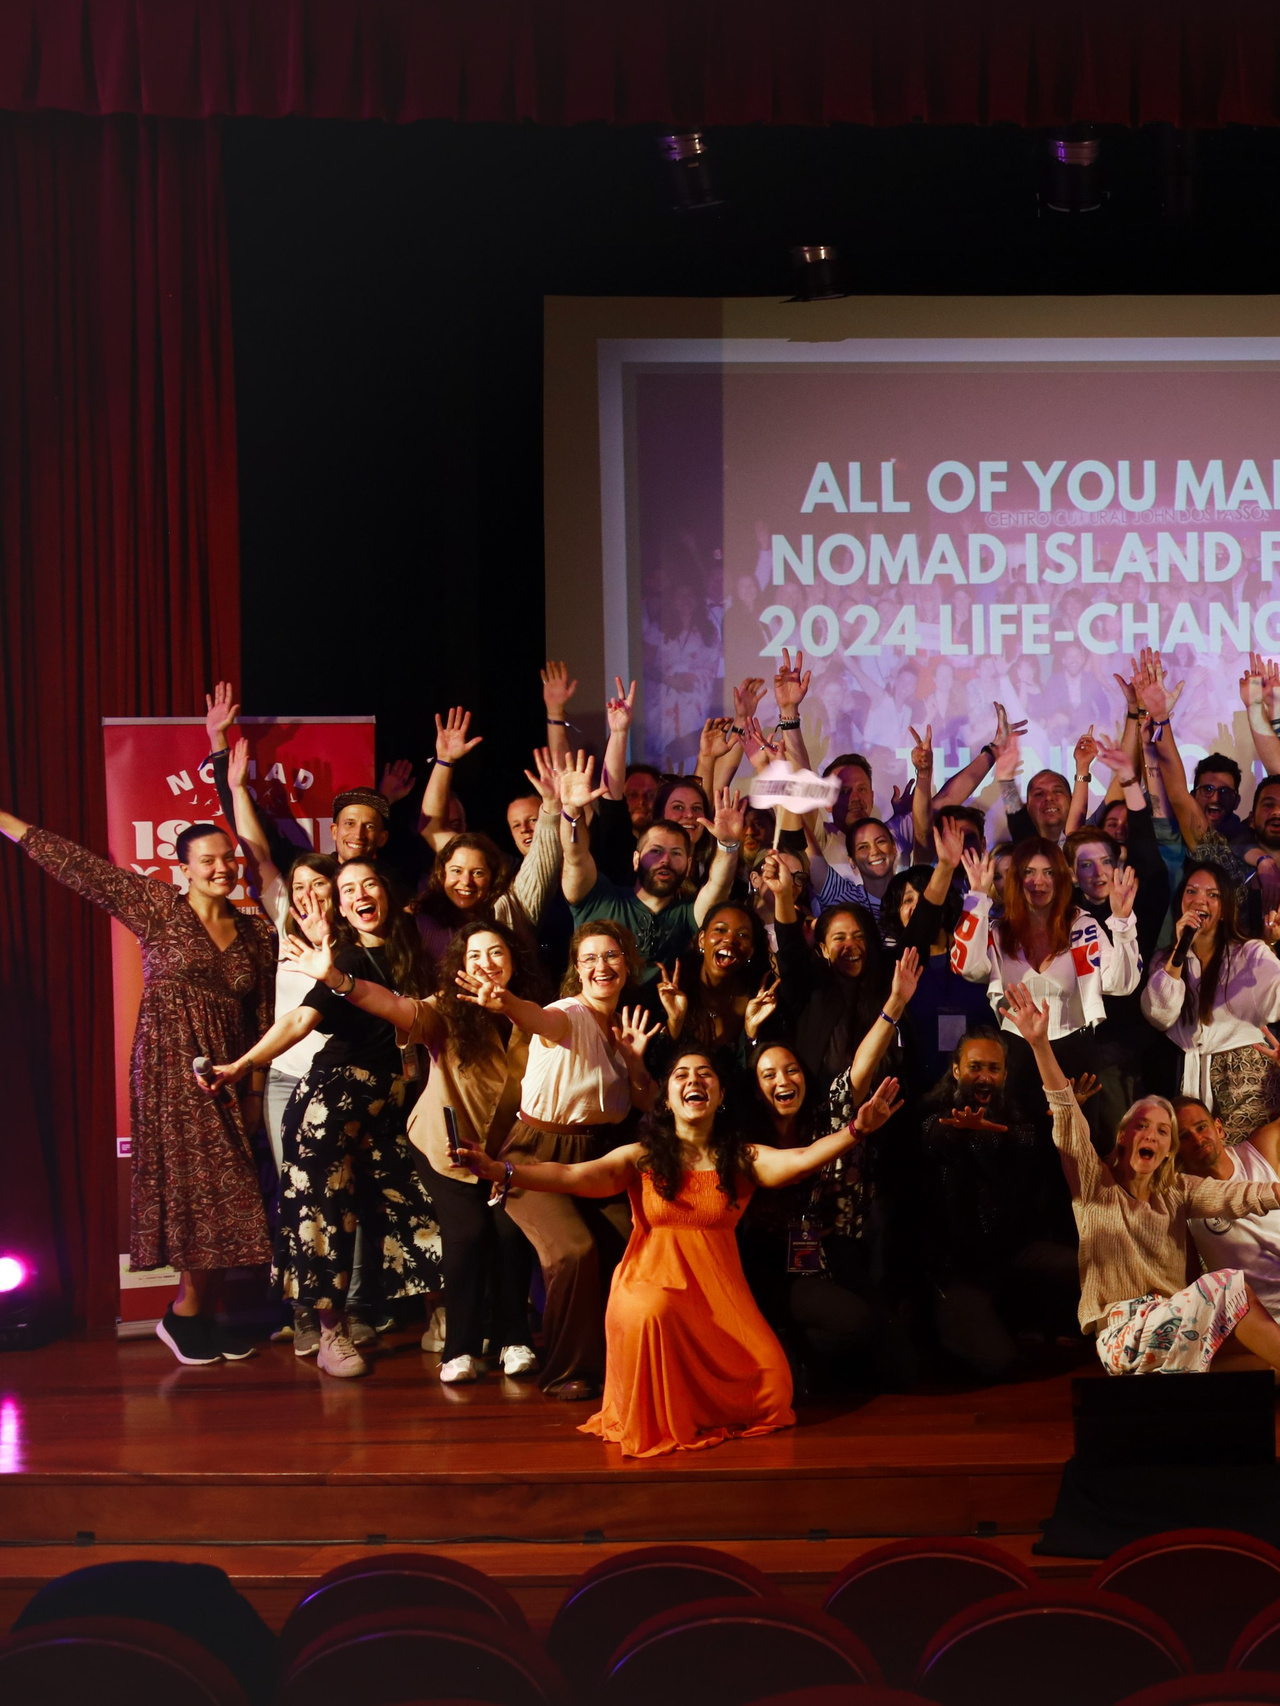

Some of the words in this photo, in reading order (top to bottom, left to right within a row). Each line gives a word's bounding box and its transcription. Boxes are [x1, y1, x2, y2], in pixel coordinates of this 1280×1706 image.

[800, 461, 911, 514] ALL
[927, 460, 1008, 514] OF
[1022, 460, 1156, 513] YOU
[986, 511, 1050, 528] CENTRO
[1134, 507, 1176, 525] JOHN
[1179, 506, 1211, 523] DOS
[771, 533, 1008, 587] NOMAD
[1025, 531, 1243, 585] ISLAND
[758, 604, 922, 658] 2024
